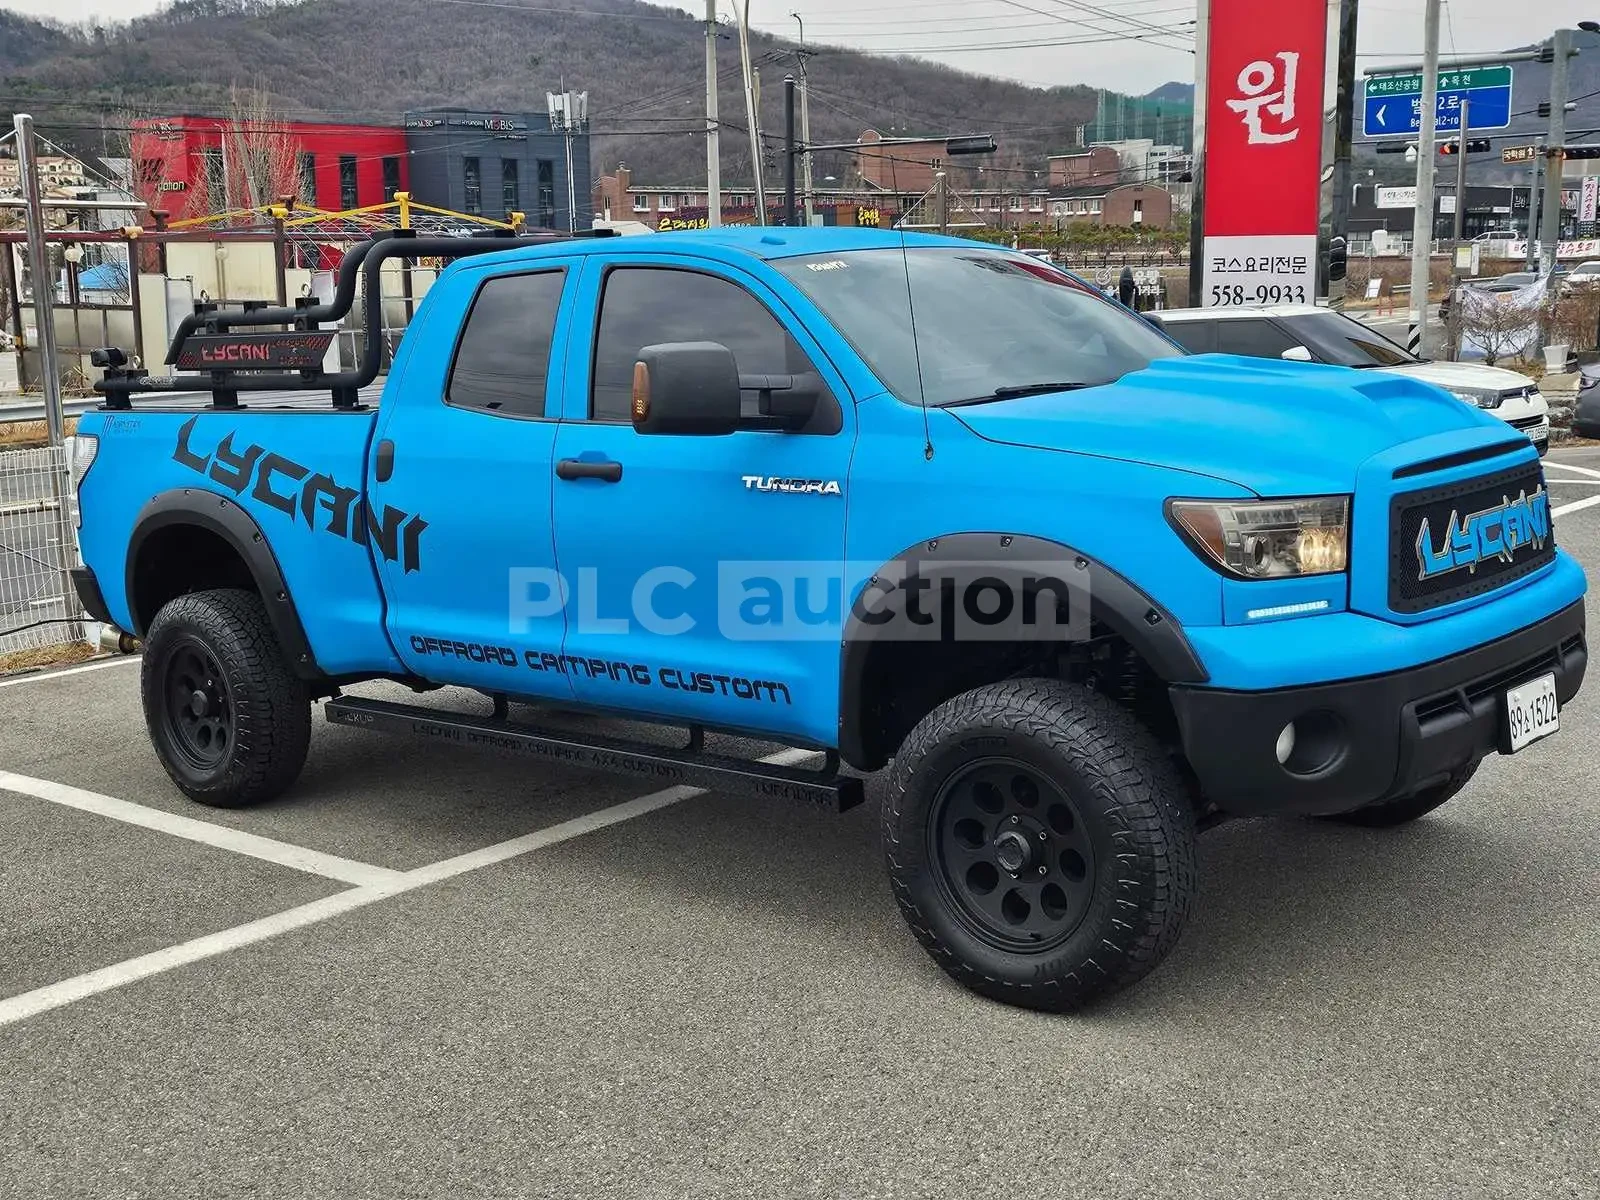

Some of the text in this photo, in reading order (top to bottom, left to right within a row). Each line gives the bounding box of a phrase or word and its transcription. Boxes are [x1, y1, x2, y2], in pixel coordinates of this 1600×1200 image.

[1378, 79, 1420, 91] 태조산공원
[1225, 51, 1300, 145] 원
[484, 119, 514, 131] MOBIS
[1211, 256, 1307, 274] 코스요리전문
[1211, 284, 1306, 307] 558-9933
[201, 343, 271, 361] LYCANI
[171, 413, 430, 576] LYCANI
[742, 475, 841, 495] TUNDRA
[1415, 484, 1548, 581] LYCANI
[409, 635, 792, 705] OFFROAD CAMPING CUSTOM
[1510, 691, 1557, 740] 89소1522
